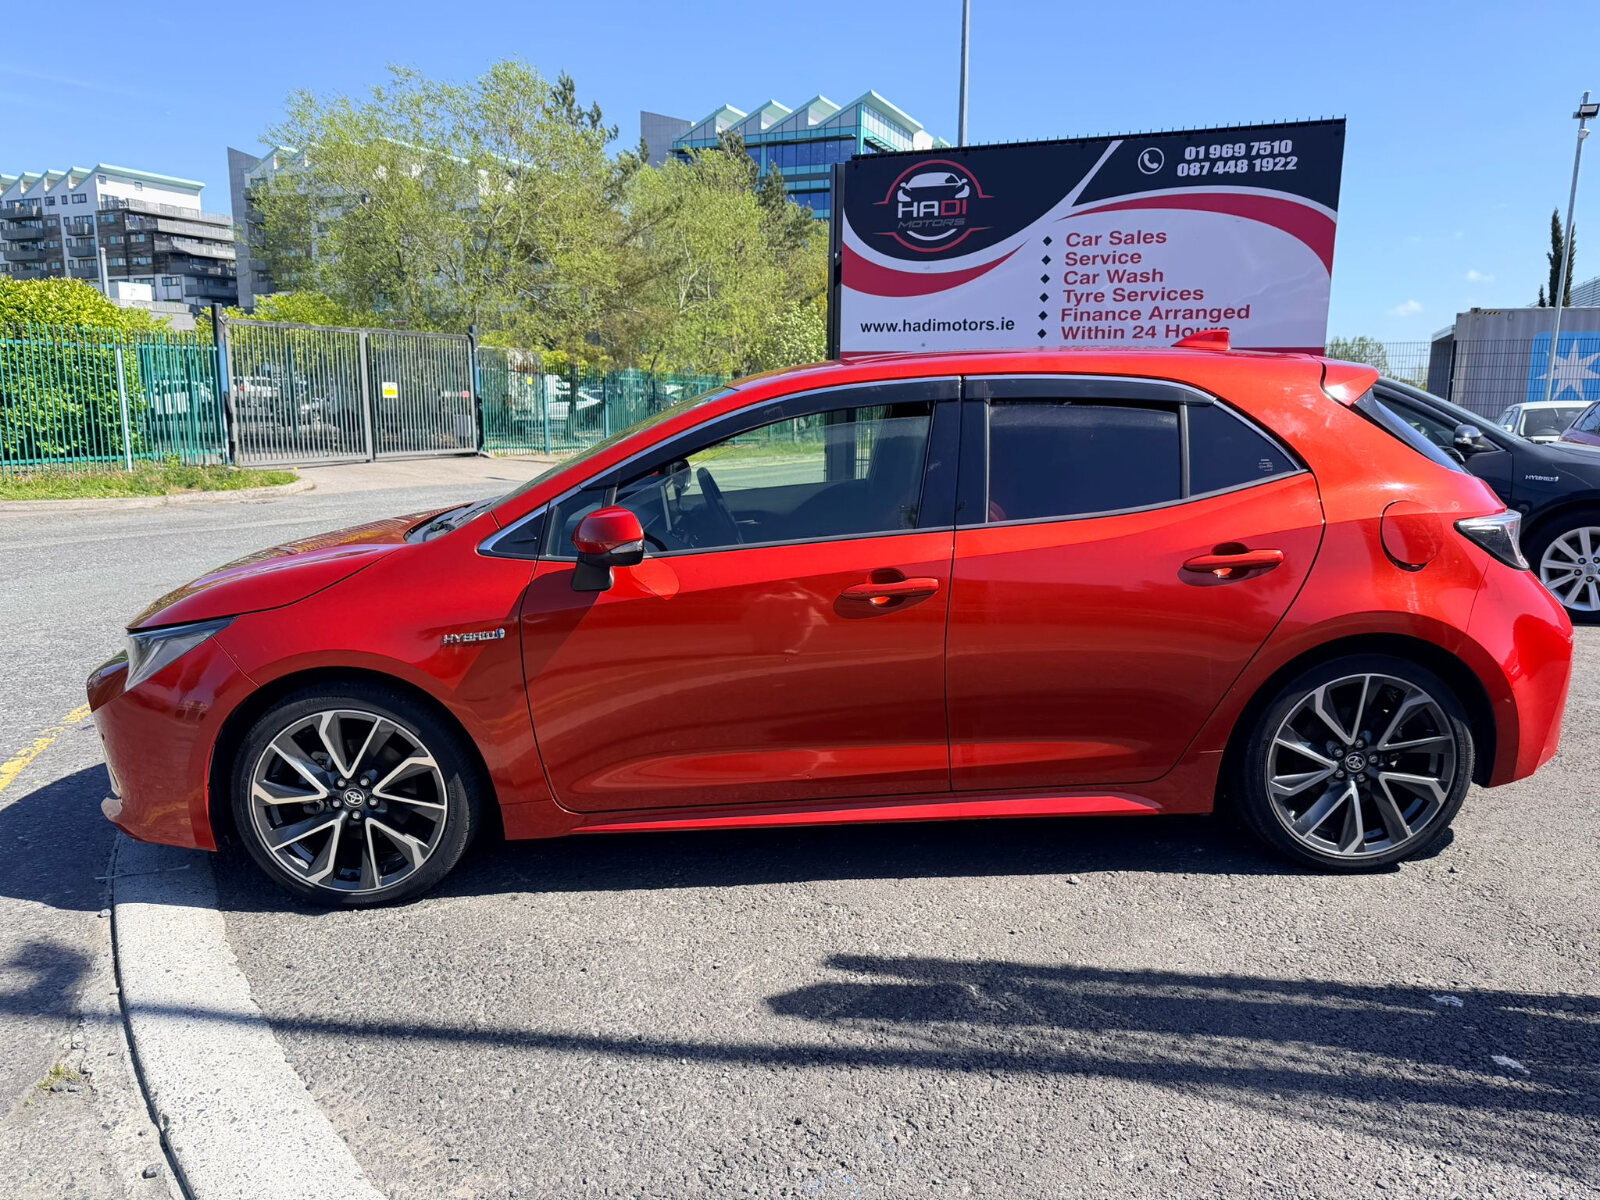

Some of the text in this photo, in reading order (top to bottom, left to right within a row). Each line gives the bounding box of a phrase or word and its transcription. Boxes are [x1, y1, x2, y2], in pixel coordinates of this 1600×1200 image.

[1184, 139, 1293, 160] 01 969 7510
[1177, 156, 1298, 177] 087 448 1922
[897, 199, 968, 218] HADI
[898, 218, 966, 229] MOTORS
[1066, 229, 1167, 247] Car Sales
[1065, 250, 1142, 266] Service
[1063, 268, 1164, 285] Car Wash
[1063, 287, 1205, 307] Tyre Services
[1061, 304, 1251, 323] Finance Arranged
[860, 316, 1015, 333] www.hadimotors.ie
[1061, 325, 1125, 340] Within
[1132, 325, 1157, 339] 24
[443, 630, 500, 643] HYBRID
